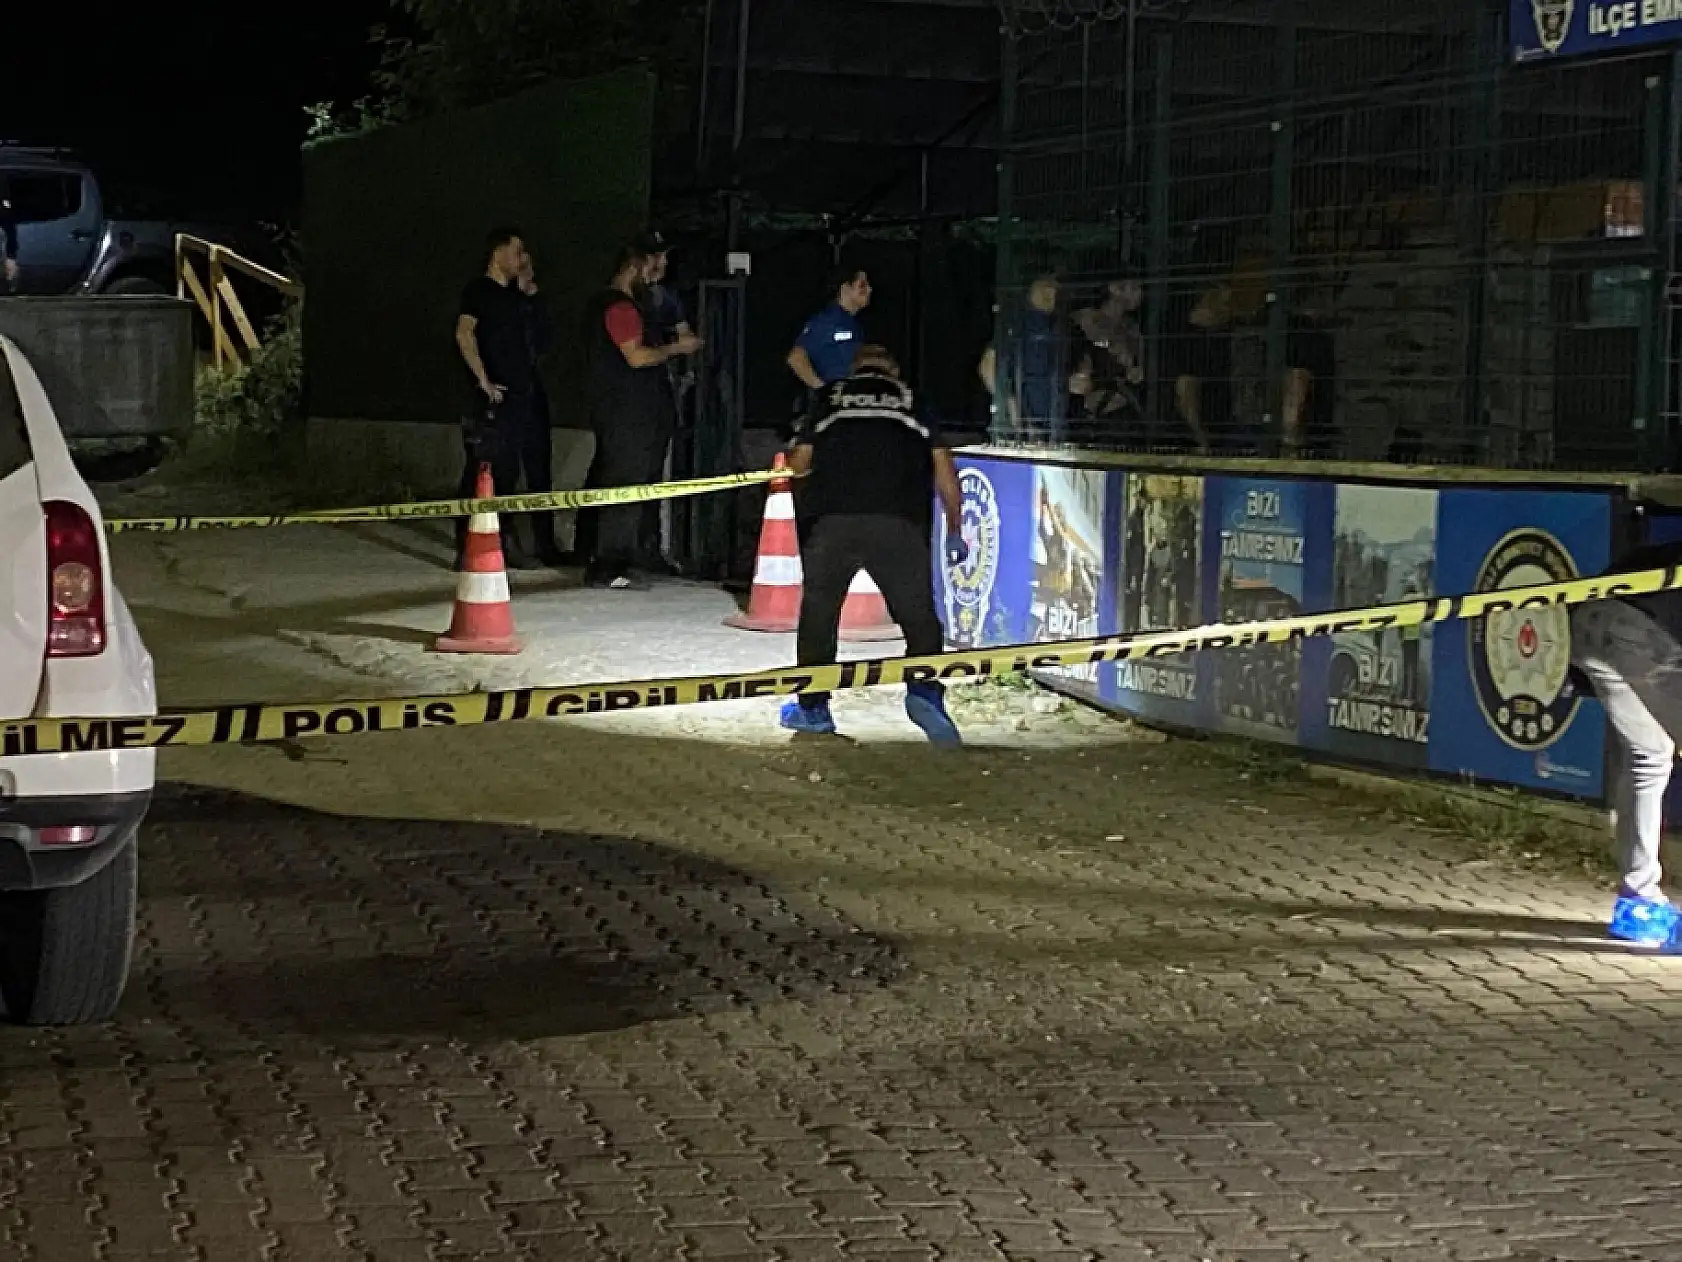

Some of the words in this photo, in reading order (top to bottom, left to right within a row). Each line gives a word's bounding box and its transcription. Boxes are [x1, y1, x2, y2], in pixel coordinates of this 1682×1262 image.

[1588, 1, 1637, 37] İLÇE
[283, 701, 456, 737] POLİS
[546, 675, 815, 716] GİRİLMEZ
